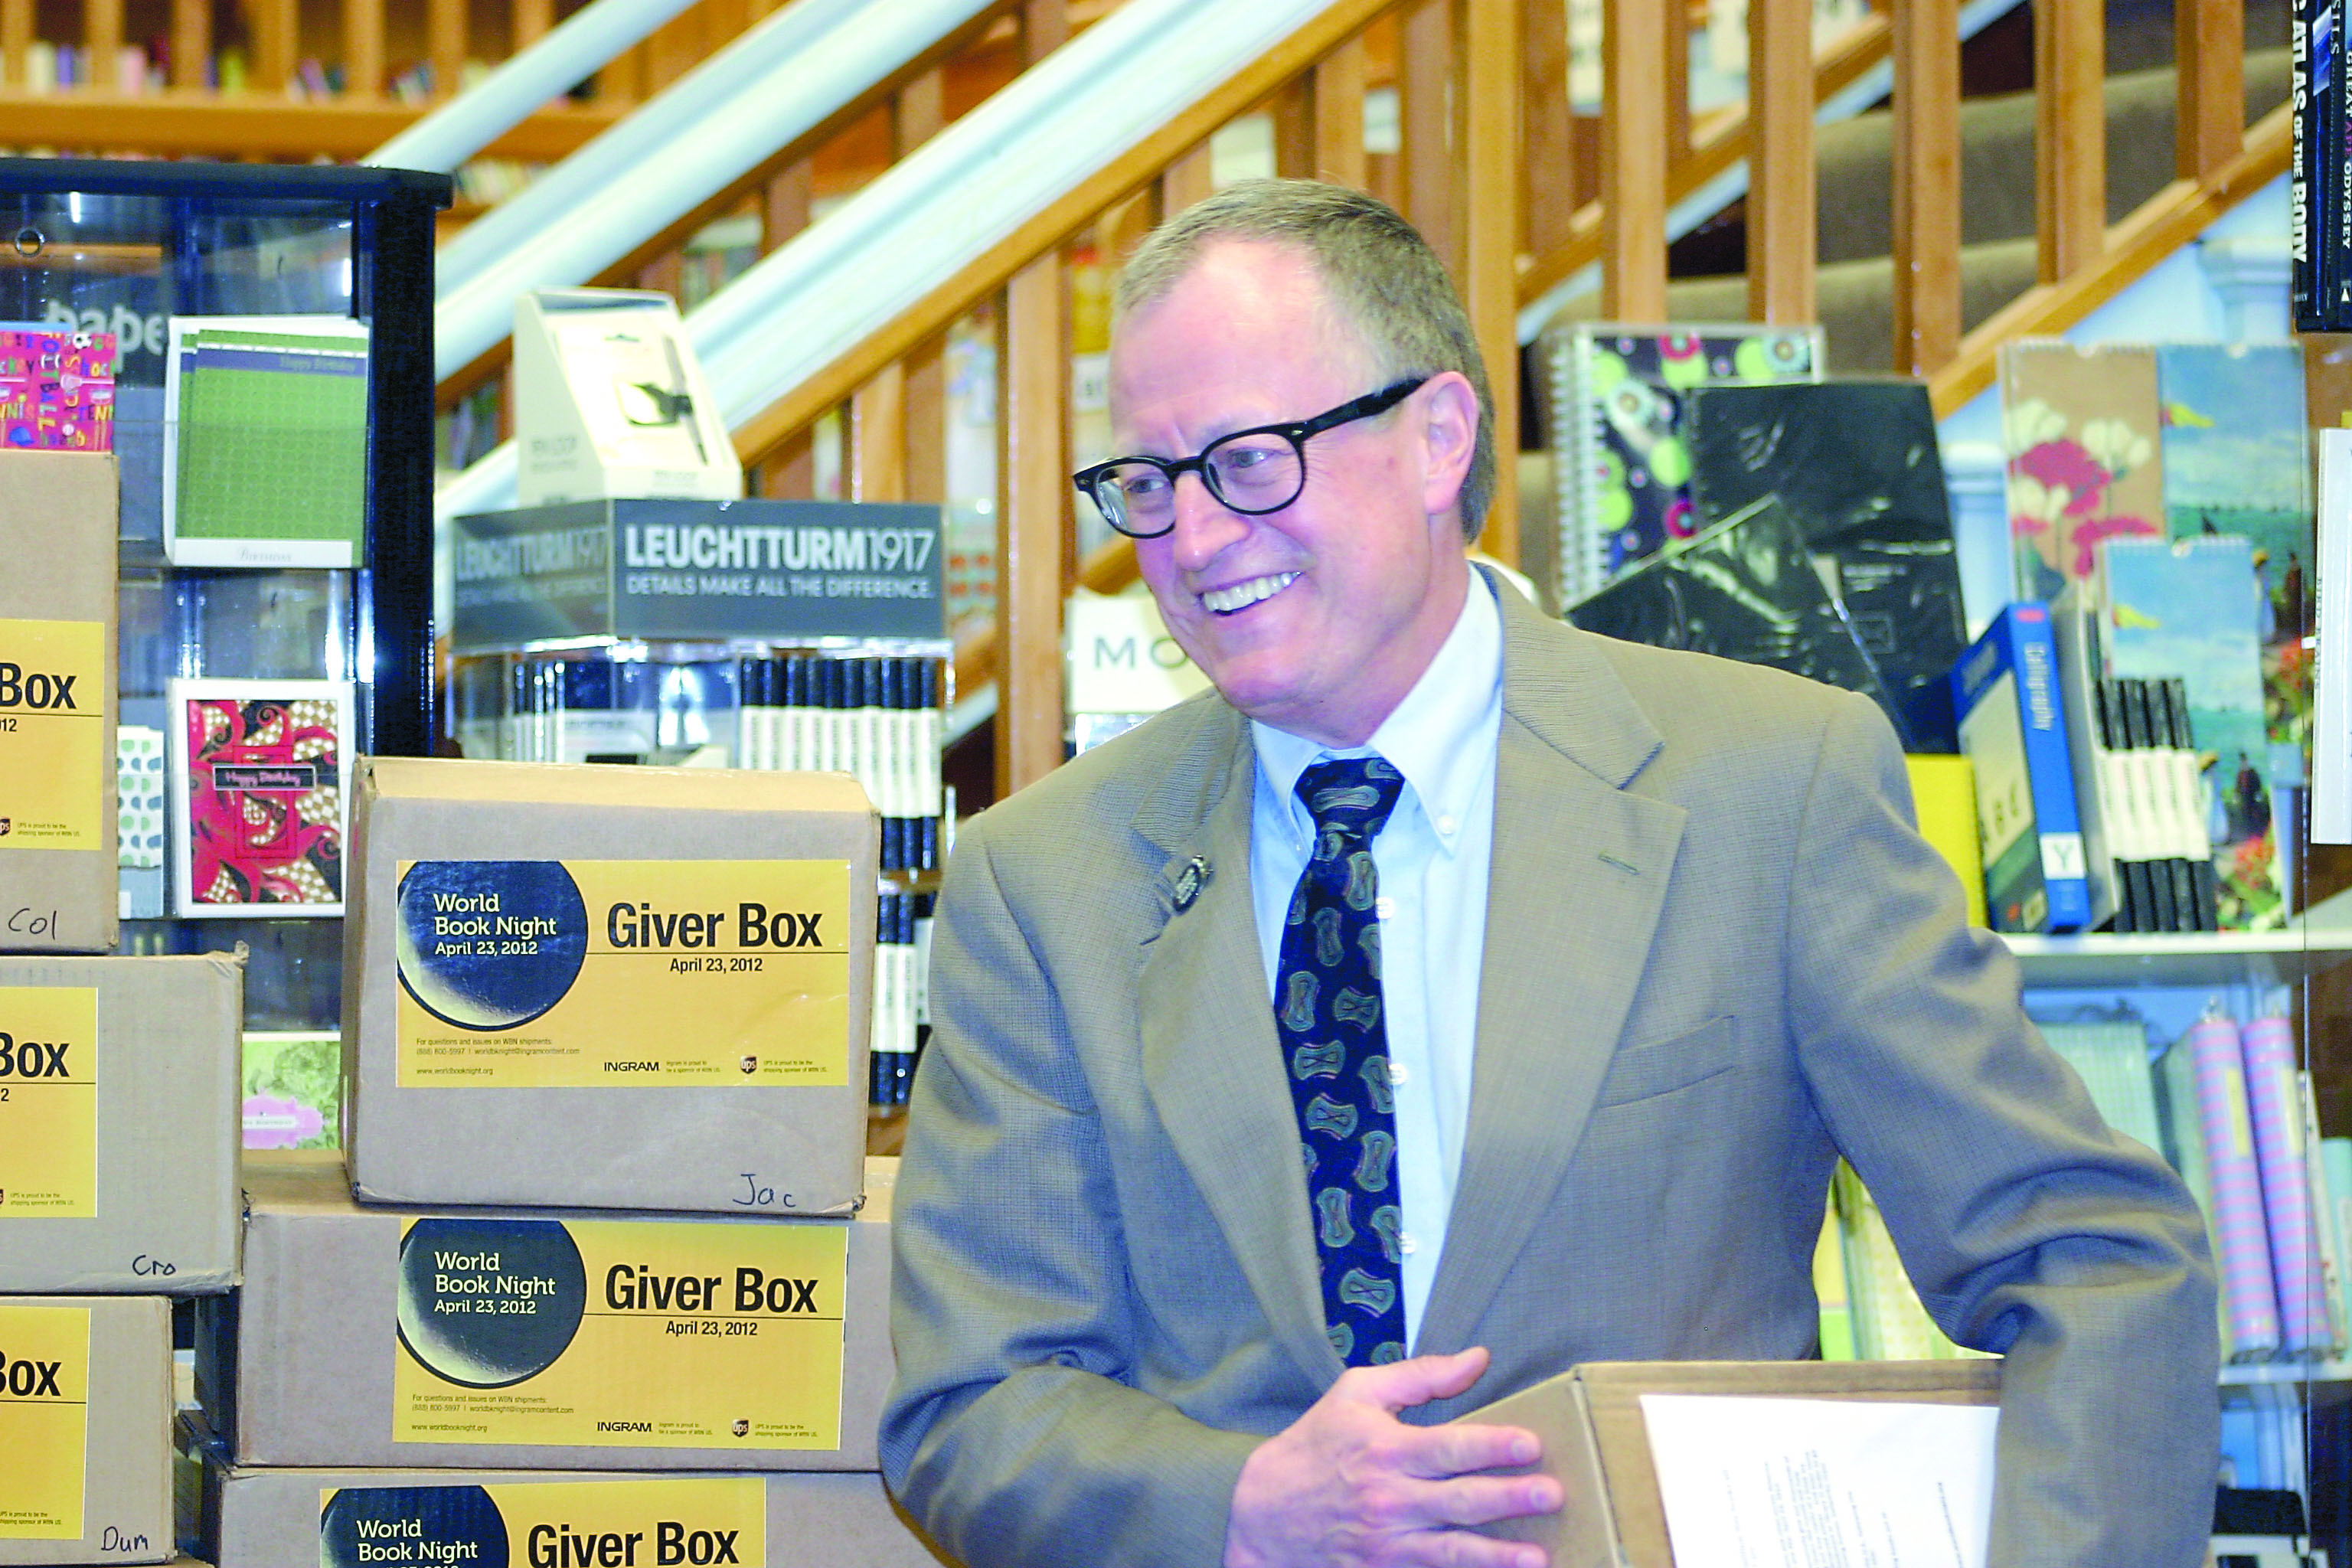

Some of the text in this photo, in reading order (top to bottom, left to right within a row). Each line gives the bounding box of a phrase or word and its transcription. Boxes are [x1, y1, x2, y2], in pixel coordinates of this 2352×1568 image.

[2292, 21, 2307, 112] ATLAS
[2294, 116, 2303, 139] OF
[2294, 142, 2303, 178] THE
[2343, 161, 2352, 250] ODYSSEY
[2292, 181, 2307, 263] BODY
[625, 524, 935, 570] LEUCHTTURM1917
[626, 574, 697, 596] DETAILS
[698, 575, 753, 596] MAKE
[755, 577, 788, 596] ALL
[789, 577, 824, 597] THE
[0, 663, 76, 709] Box
[0, 718, 17, 732] 12
[433, 893, 499, 912] World
[435, 916, 556, 939] Book Night
[608, 903, 822, 948] Giver Box
[436, 942, 537, 957] April 23, 2012
[671, 959, 762, 974] April 23, 2012
[605, 1062, 658, 1071] INGRAM
[733, 1174, 795, 1207] Jac
[435, 1252, 499, 1270] World
[436, 1275, 555, 1298] Book Night
[606, 1265, 818, 1312] Giver Box
[435, 1299, 536, 1315] April 23, 2012
[666, 1321, 757, 1338] April 23, 2012
[0, 1351, 61, 1396] ox
[598, 1423, 652, 1432] INGRAM
[733, 1422, 747, 1435] ups
[101, 1527, 148, 1552] Dum
[357, 1519, 422, 1537] World
[358, 1541, 478, 1563] Book Night
[528, 1522, 739, 1568] Giver Box
